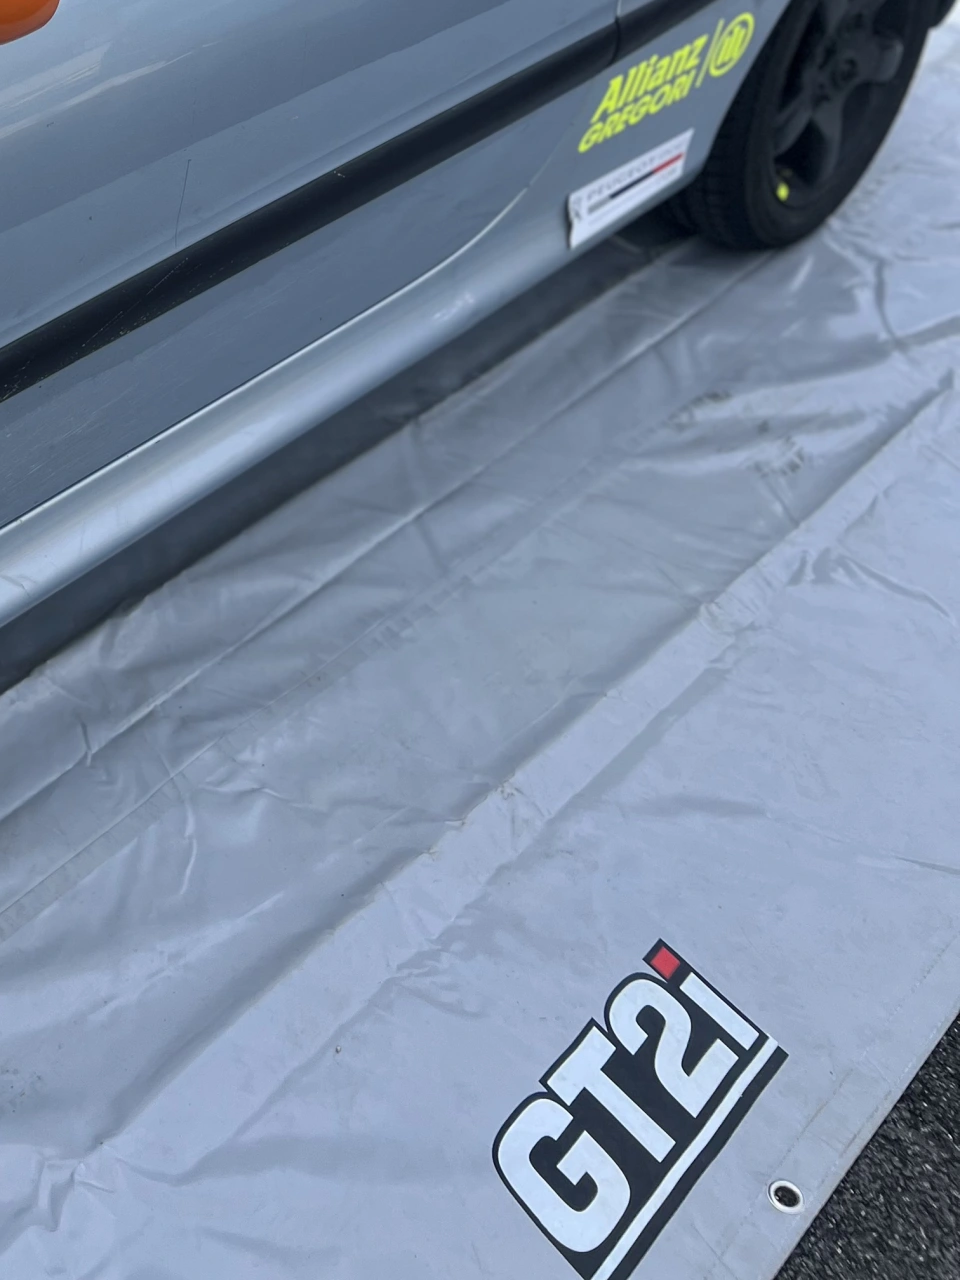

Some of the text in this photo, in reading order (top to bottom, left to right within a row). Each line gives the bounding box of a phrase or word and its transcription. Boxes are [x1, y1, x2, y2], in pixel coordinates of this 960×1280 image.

[578, 69, 696, 153] GREGORI
[591, 34, 709, 124] Allianz
[494, 939, 767, 1254] GT2i
